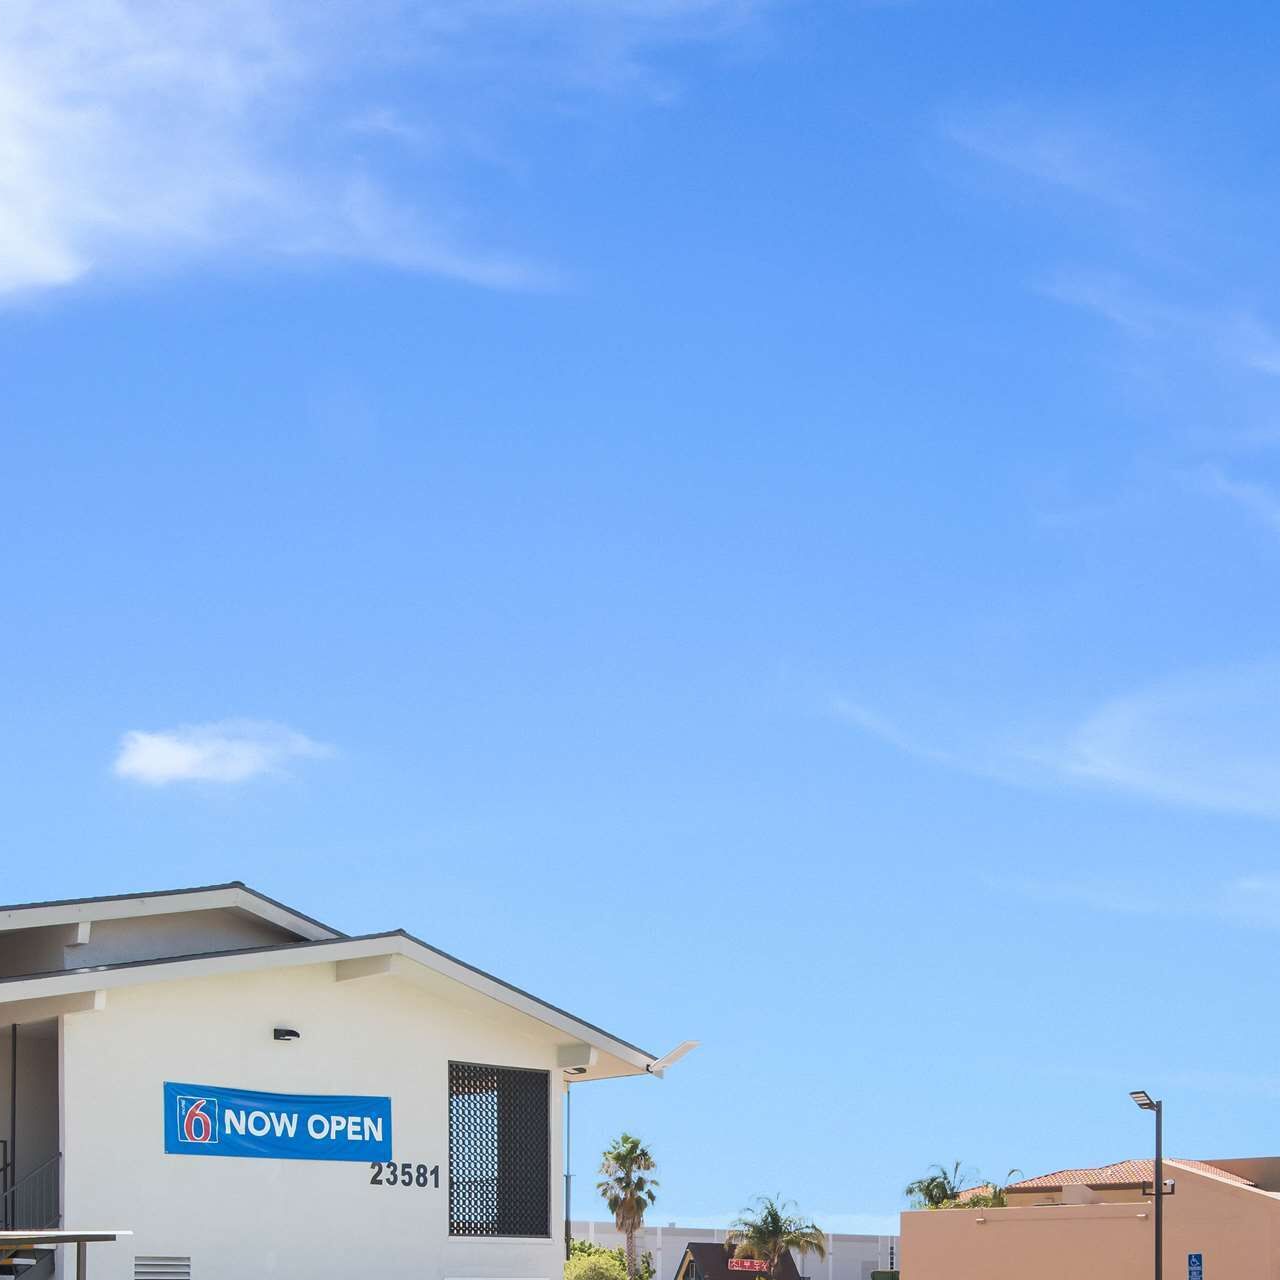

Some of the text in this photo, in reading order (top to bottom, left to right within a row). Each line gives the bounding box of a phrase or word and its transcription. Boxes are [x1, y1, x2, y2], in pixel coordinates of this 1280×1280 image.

[183, 1099, 383, 1142] 6 NOW OPEN
[370, 1161, 440, 1189] 23581
